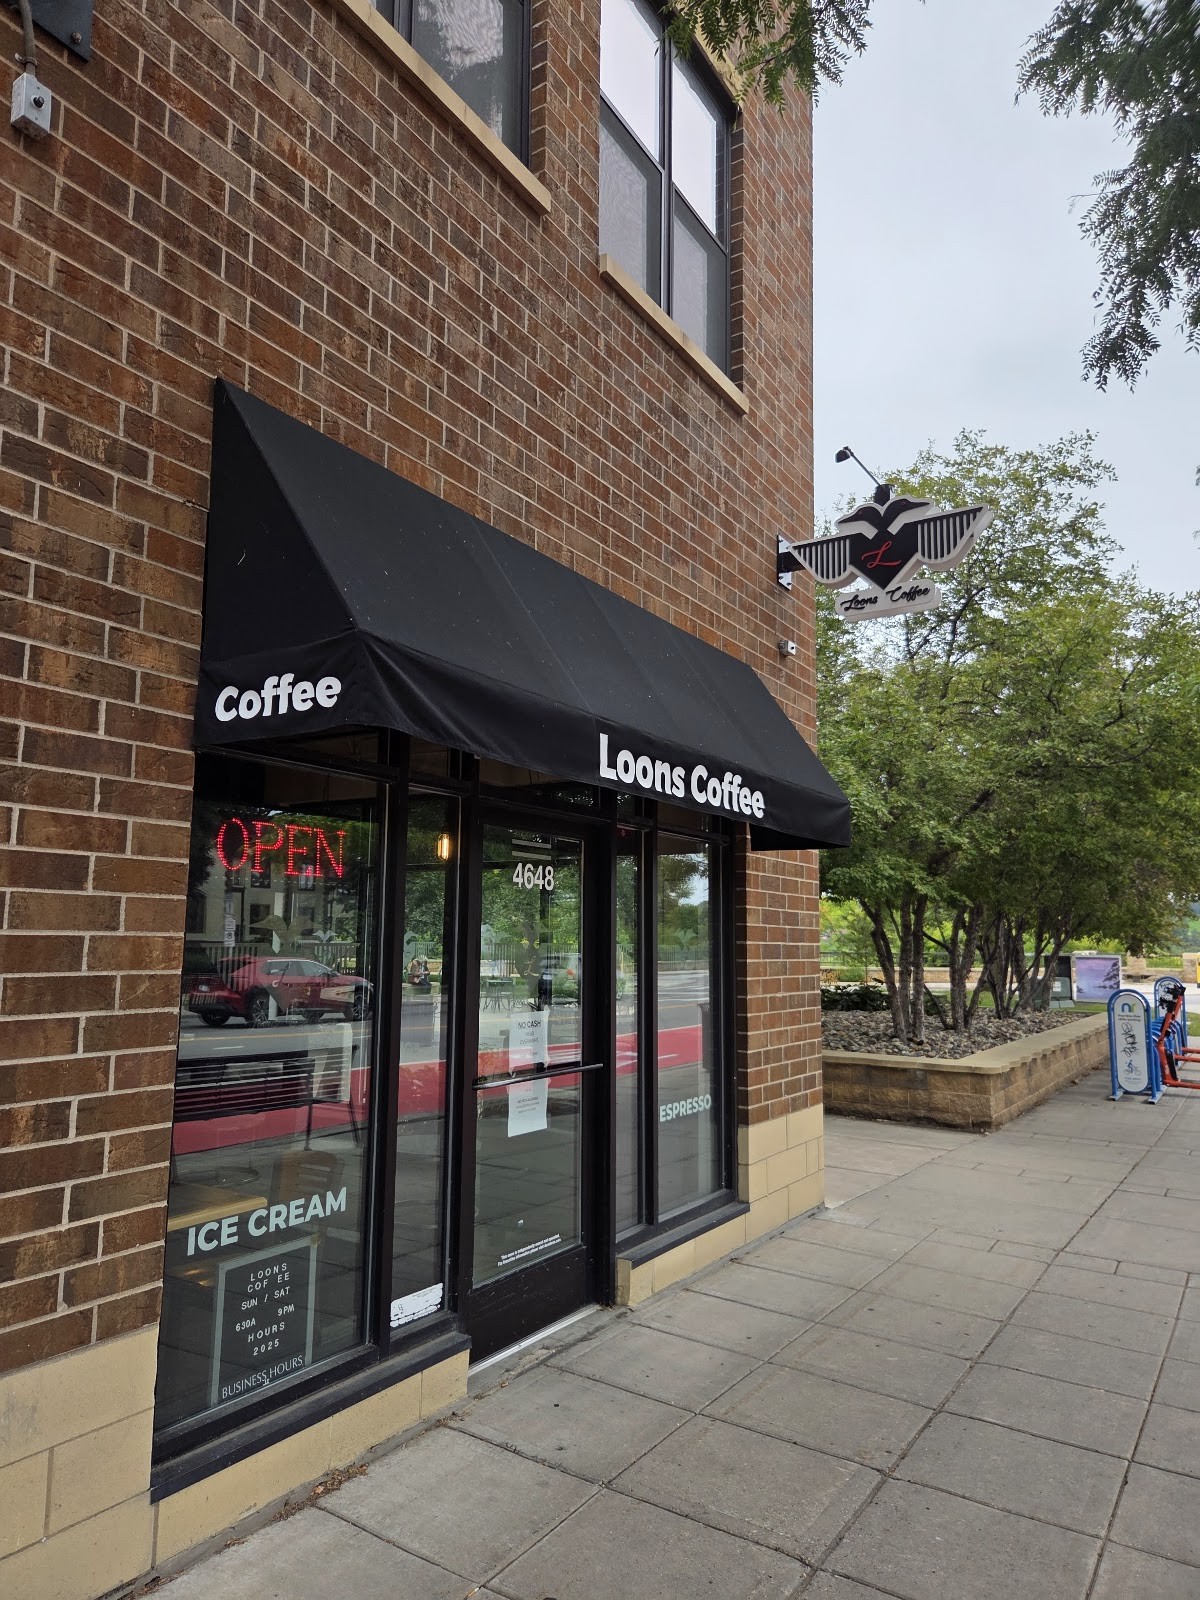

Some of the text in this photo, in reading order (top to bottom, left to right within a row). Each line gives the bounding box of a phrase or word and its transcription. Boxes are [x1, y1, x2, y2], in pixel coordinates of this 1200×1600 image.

[840, 584, 931, 611] Loons Coffee
[214, 672, 342, 722] Coffee
[599, 732, 766, 819] Loons Coffee
[215, 816, 346, 879] OPEN
[512, 862, 555, 891] 4648
[659, 1093, 712, 1123] ESPRESSO
[186, 1187, 347, 1256] ICE CREAM
[250, 1263, 288, 1282] LOONS
[241, 1297, 258, 1311] SUN
[274, 1286, 291, 1299] SAT
[235, 1303, 295, 1332] 630A 9PM
[247, 1321, 285, 1343] HOURS
[253, 1338, 280, 1356] 2025
[222, 1355, 304, 1399] BUSINESS HOURS
